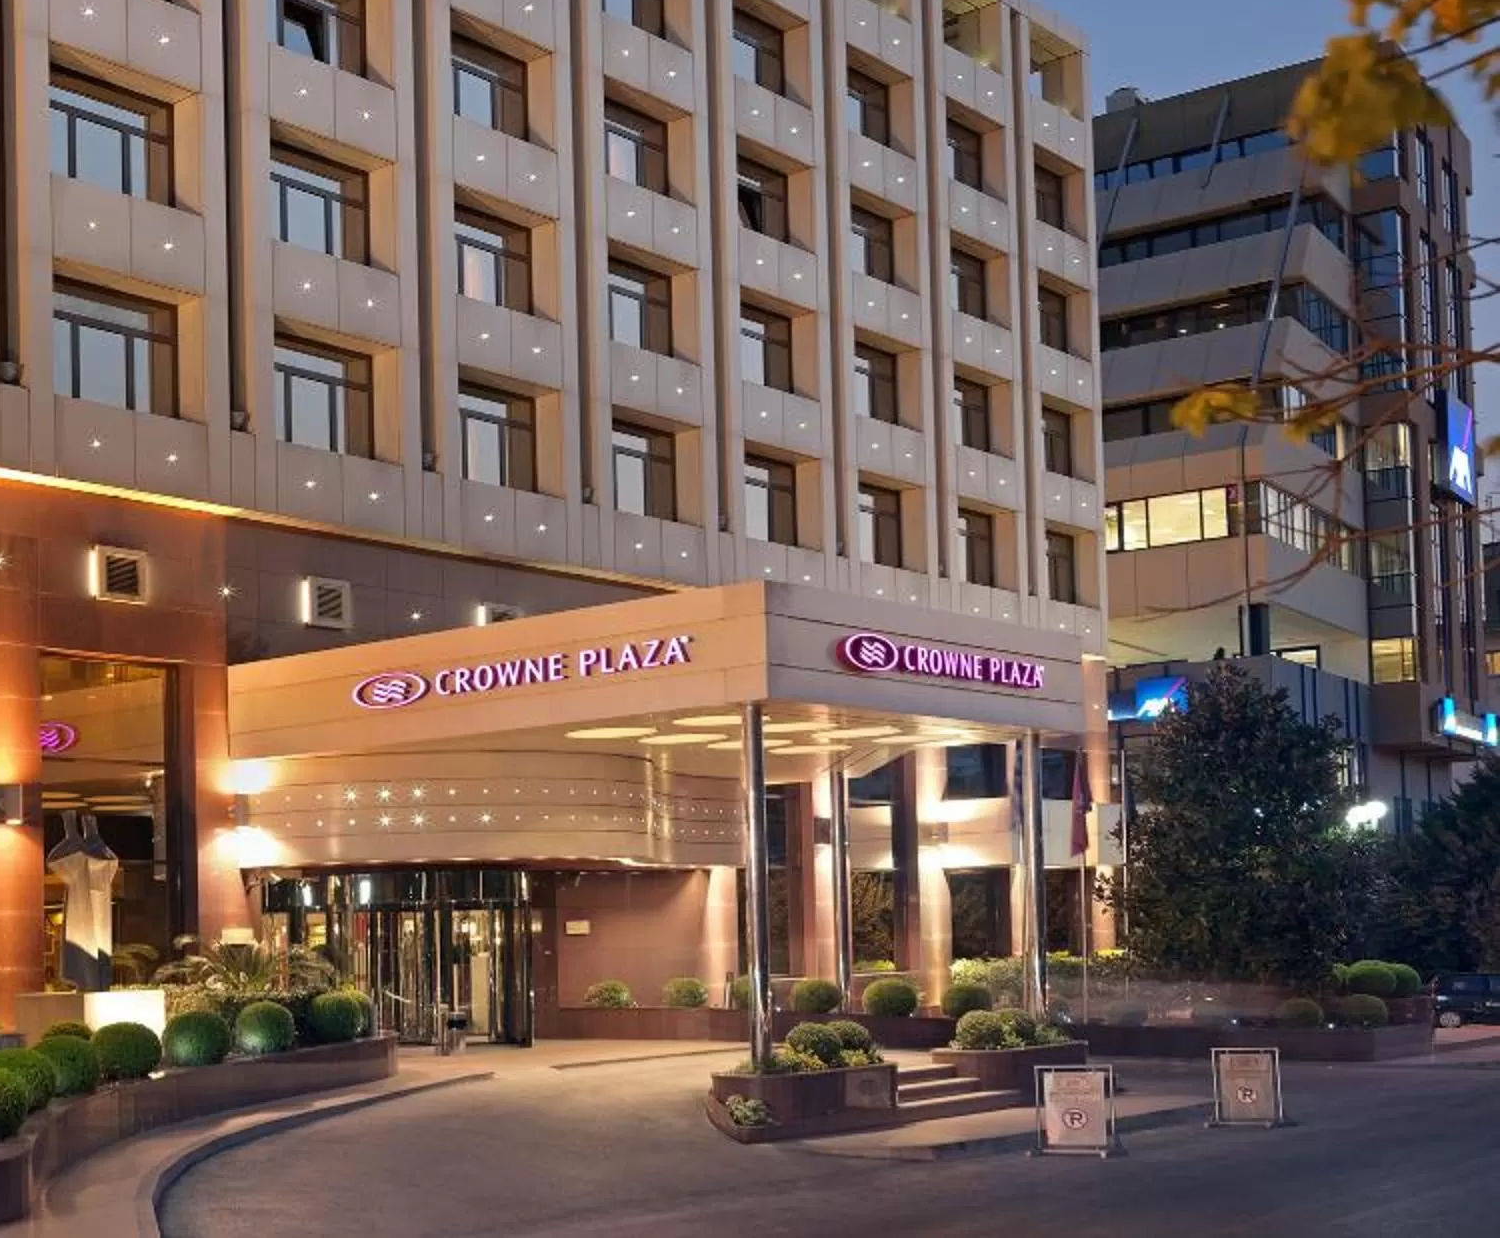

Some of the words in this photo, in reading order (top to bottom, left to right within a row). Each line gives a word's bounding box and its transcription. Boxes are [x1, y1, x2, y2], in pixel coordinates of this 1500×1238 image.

[436, 653, 566, 695] CROWNE
[579, 635, 691, 677] PLAZA
[903, 645, 983, 681] CROWNE
[989, 657, 1044, 688] PLAZA
